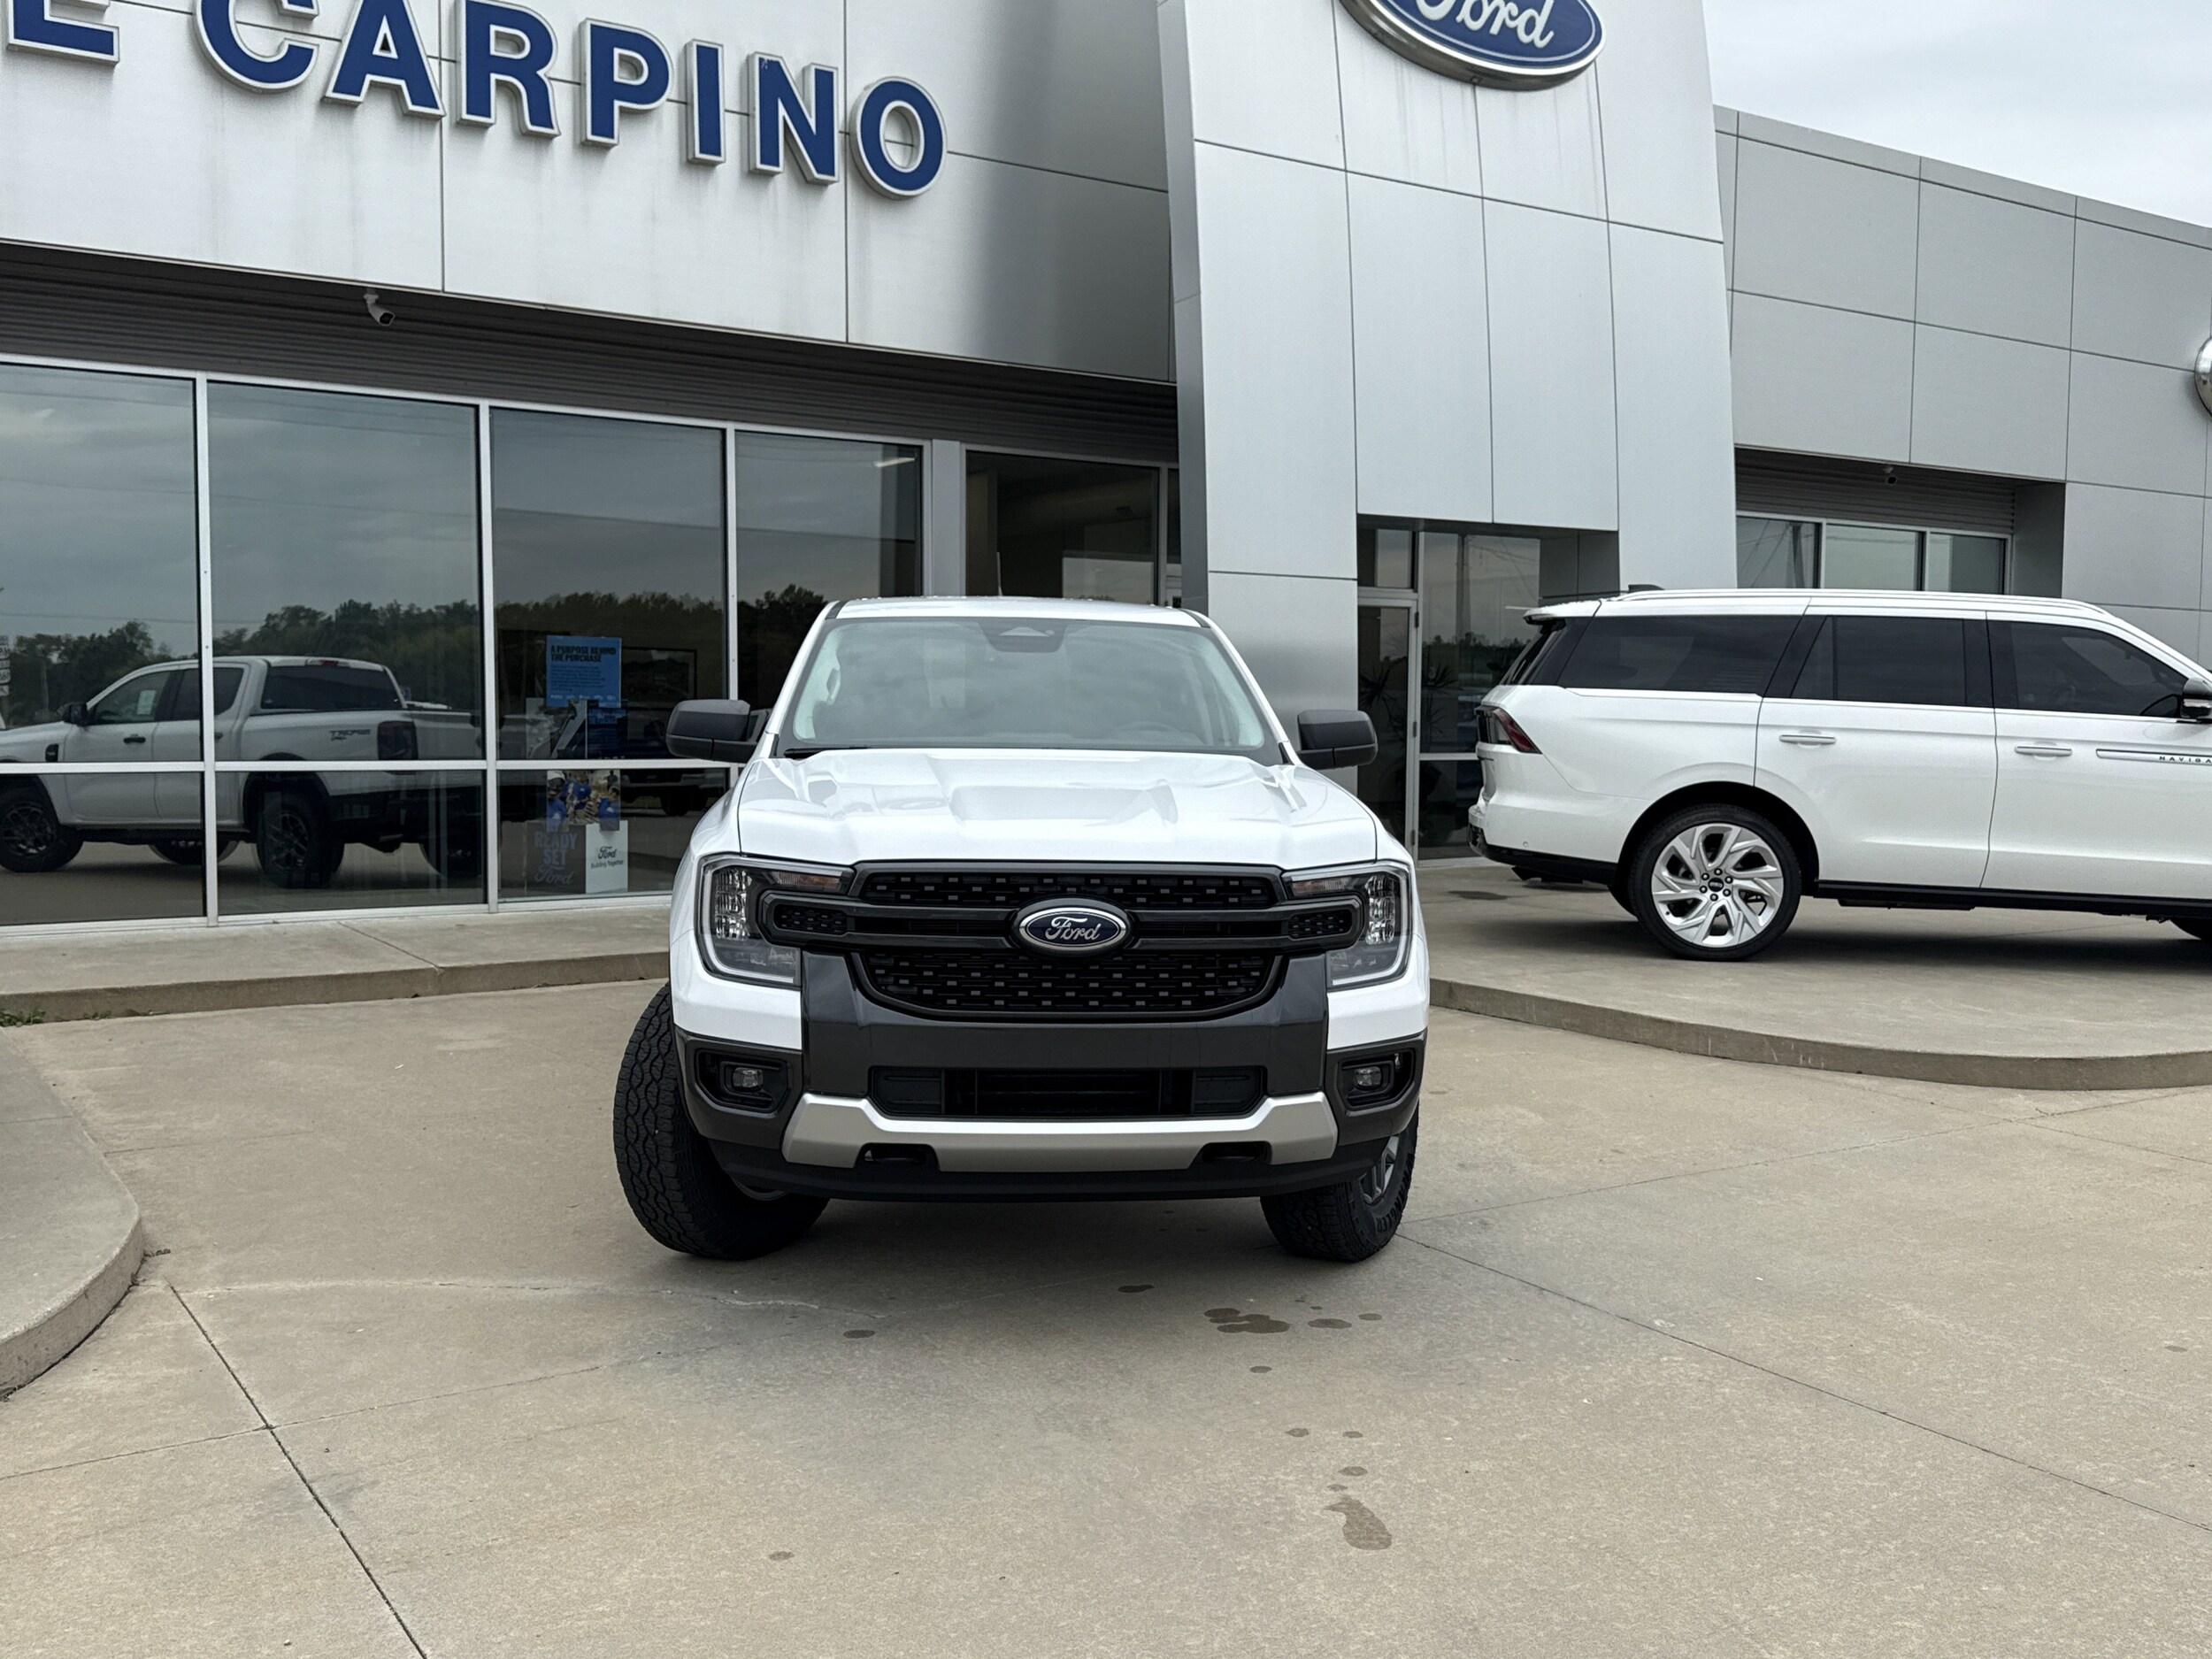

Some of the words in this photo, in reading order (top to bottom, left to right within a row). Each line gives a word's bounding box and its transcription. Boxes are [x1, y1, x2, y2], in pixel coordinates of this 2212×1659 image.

[1416, 0, 1555, 49] ord
[192, 0, 948, 200] CARPINO
[550, 653, 563, 662] THE
[565, 654, 602, 663] PURCHASE
[557, 645, 588, 654] PURPOSE
[534, 831, 577, 849] READY
[543, 849, 567, 865] SET
[597, 846, 618, 860] Ford
[534, 864, 575, 885] Ford
[1045, 916, 1102, 941] Ford
